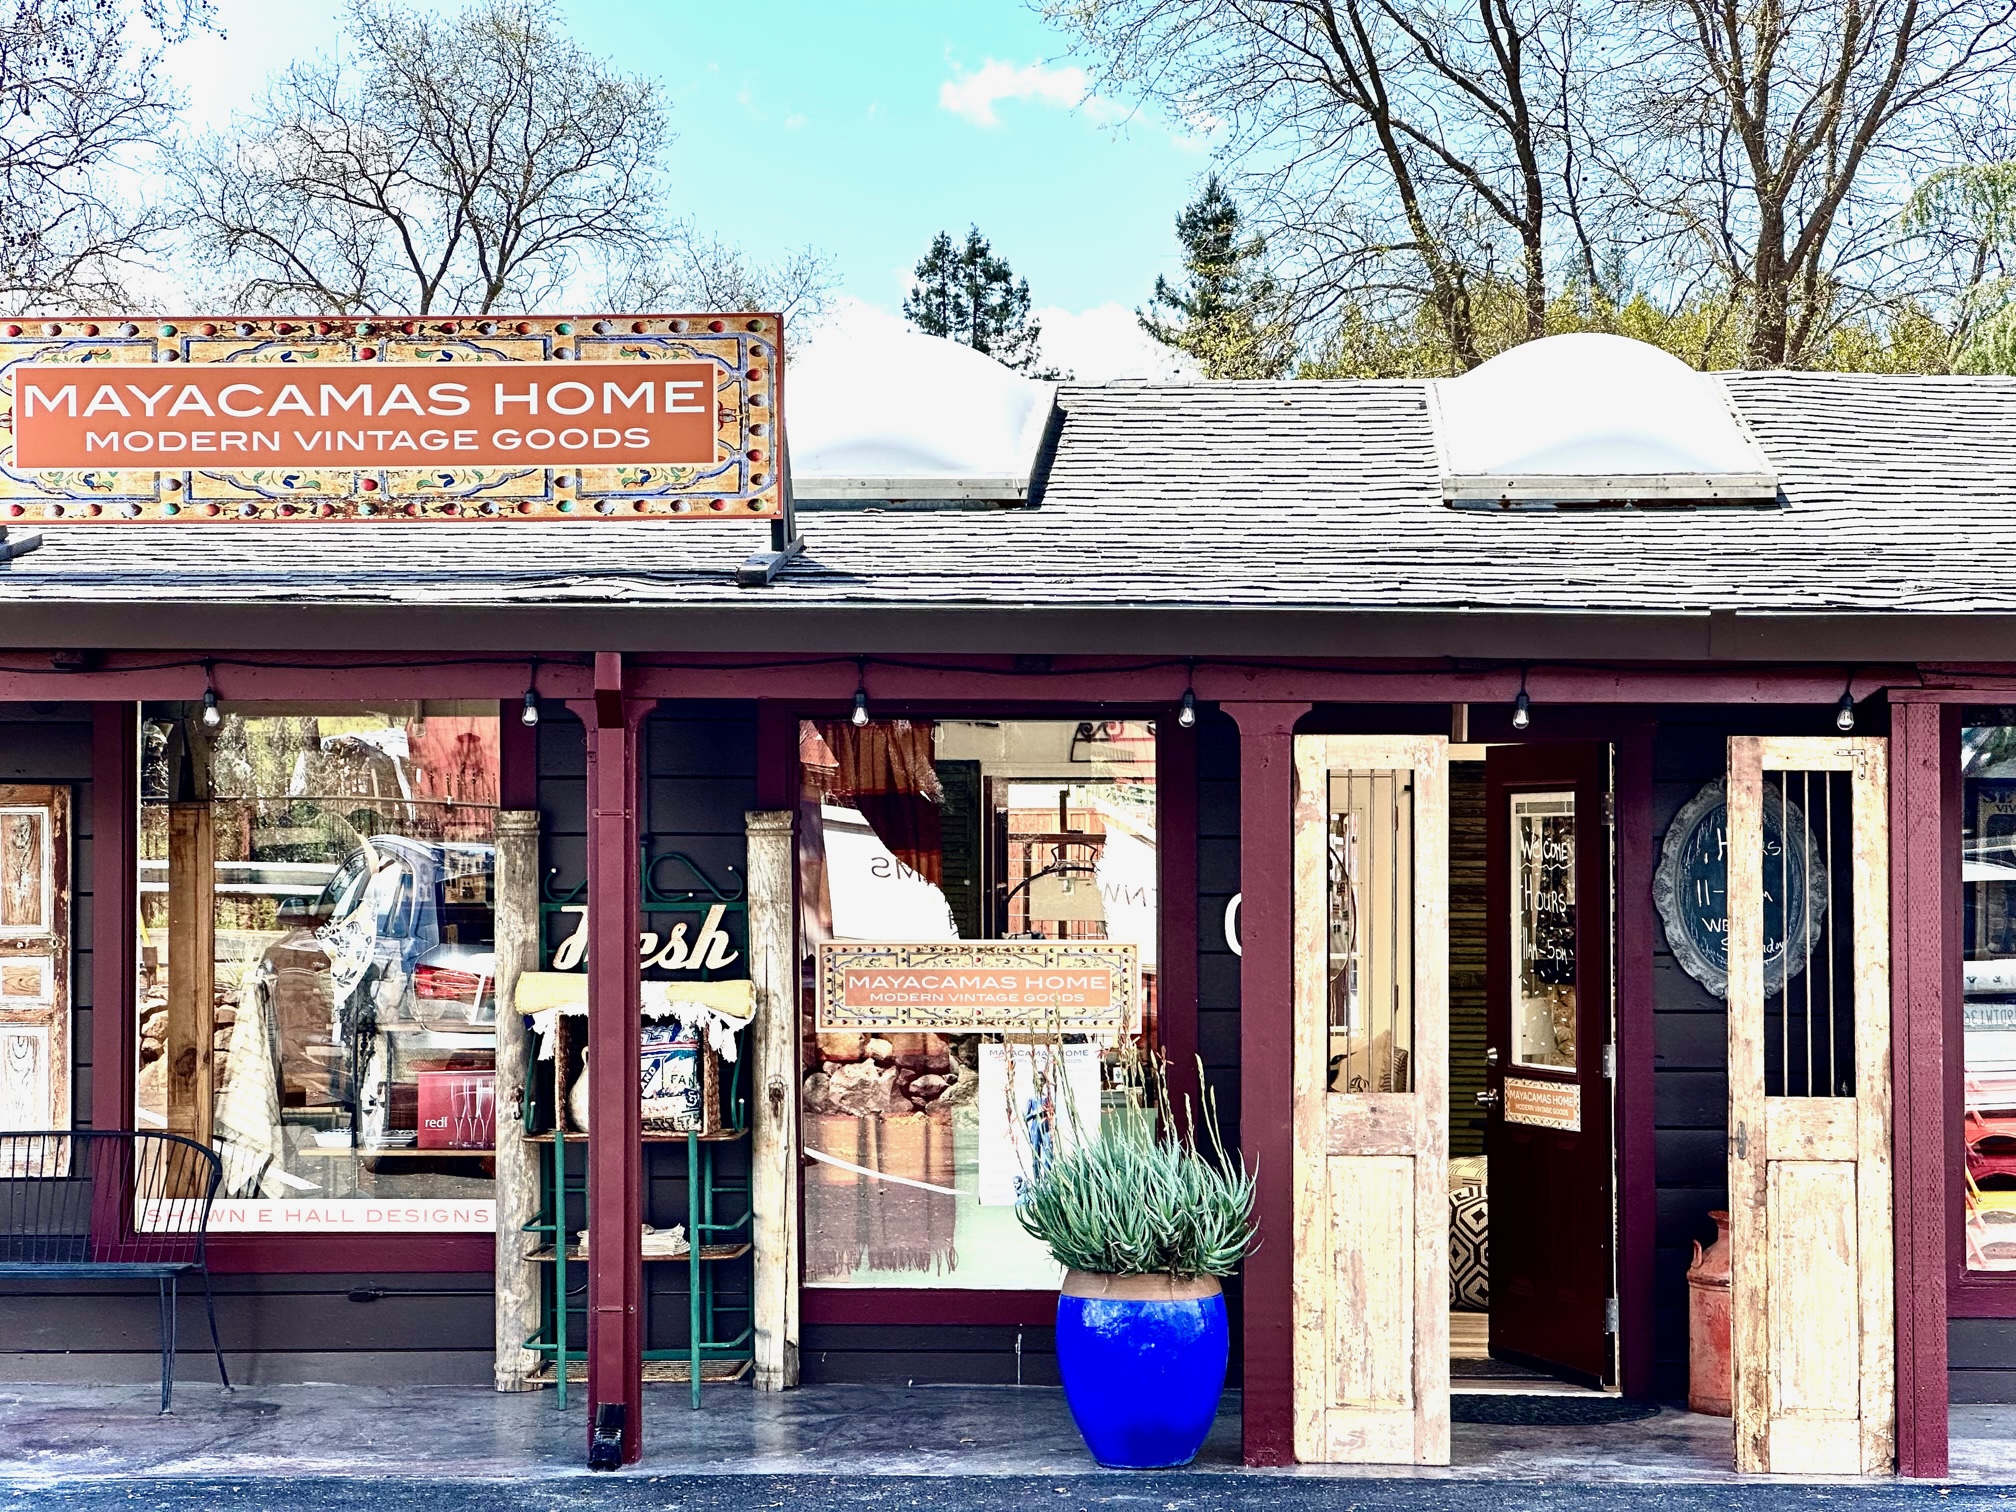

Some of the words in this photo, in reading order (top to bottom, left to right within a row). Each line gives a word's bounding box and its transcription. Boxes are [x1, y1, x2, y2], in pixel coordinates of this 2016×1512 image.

[24, 383, 471, 417] MAYACAMAS
[494, 381, 705, 415] HOME
[86, 430, 280, 452] MODERN
[293, 429, 479, 451] VINTAGE
[492, 428, 651, 450] GOODS
[849, 975, 1016, 990] MAYACAMAS
[1025, 975, 1107, 990] HOME
[870, 992, 948, 1003] MODERN
[949, 992, 1021, 1003] VINTAGE
[1023, 992, 1085, 1003] GOODS
[1509, 1090, 1552, 1105] MAYACAMAS
[1553, 1096, 1574, 1107] HOME
[1515, 1103, 1535, 1112] MODERN
[1553, 1107, 1569, 1116] GOODS
[147, 1208, 246, 1223] SHAWN
[258, 1209, 273, 1223] E
[285, 1209, 355, 1223] HALL
[366, 1208, 490, 1223] DESIGNS
